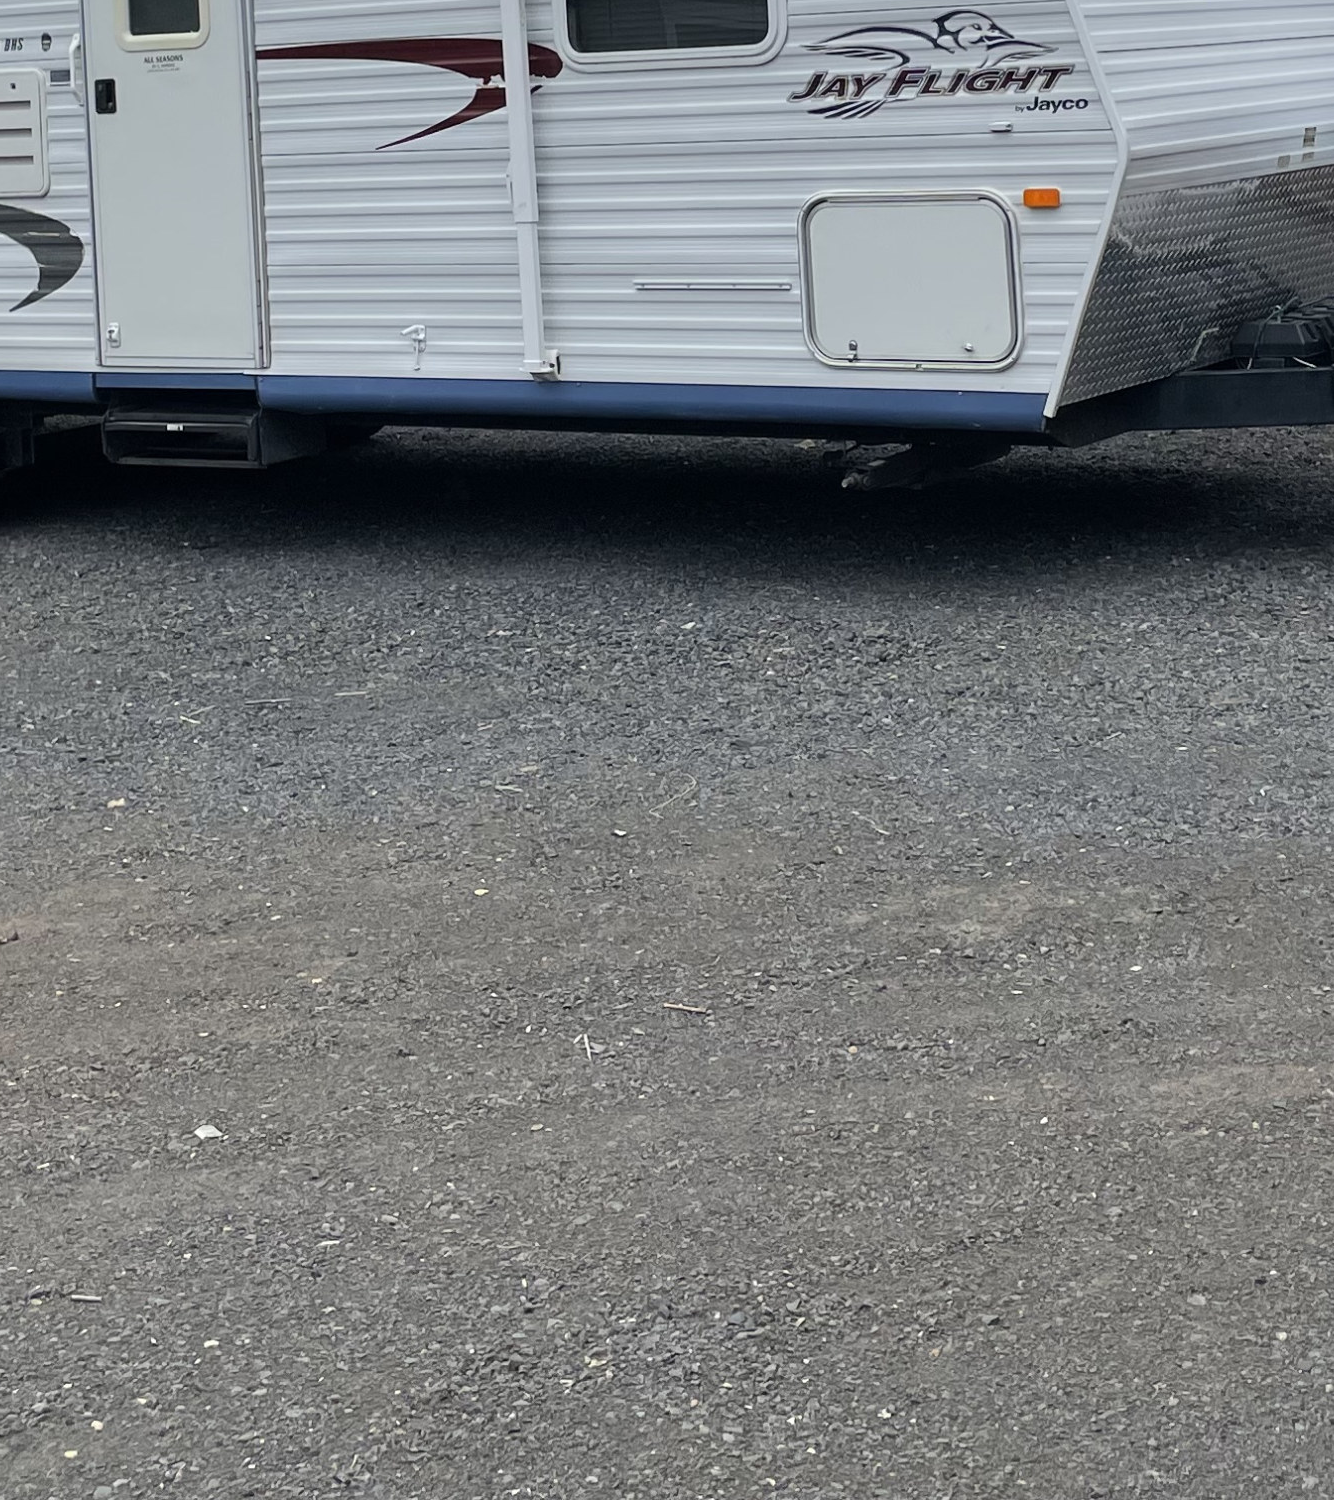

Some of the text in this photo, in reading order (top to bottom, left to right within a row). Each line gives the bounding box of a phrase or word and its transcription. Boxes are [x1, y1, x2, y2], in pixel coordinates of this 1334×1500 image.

[4, 37, 24, 52] BHS
[156, 54, 183, 63] SEASONS
[787, 65, 1075, 102] JAY FLIGHT
[1015, 96, 1088, 114] by Jayco
